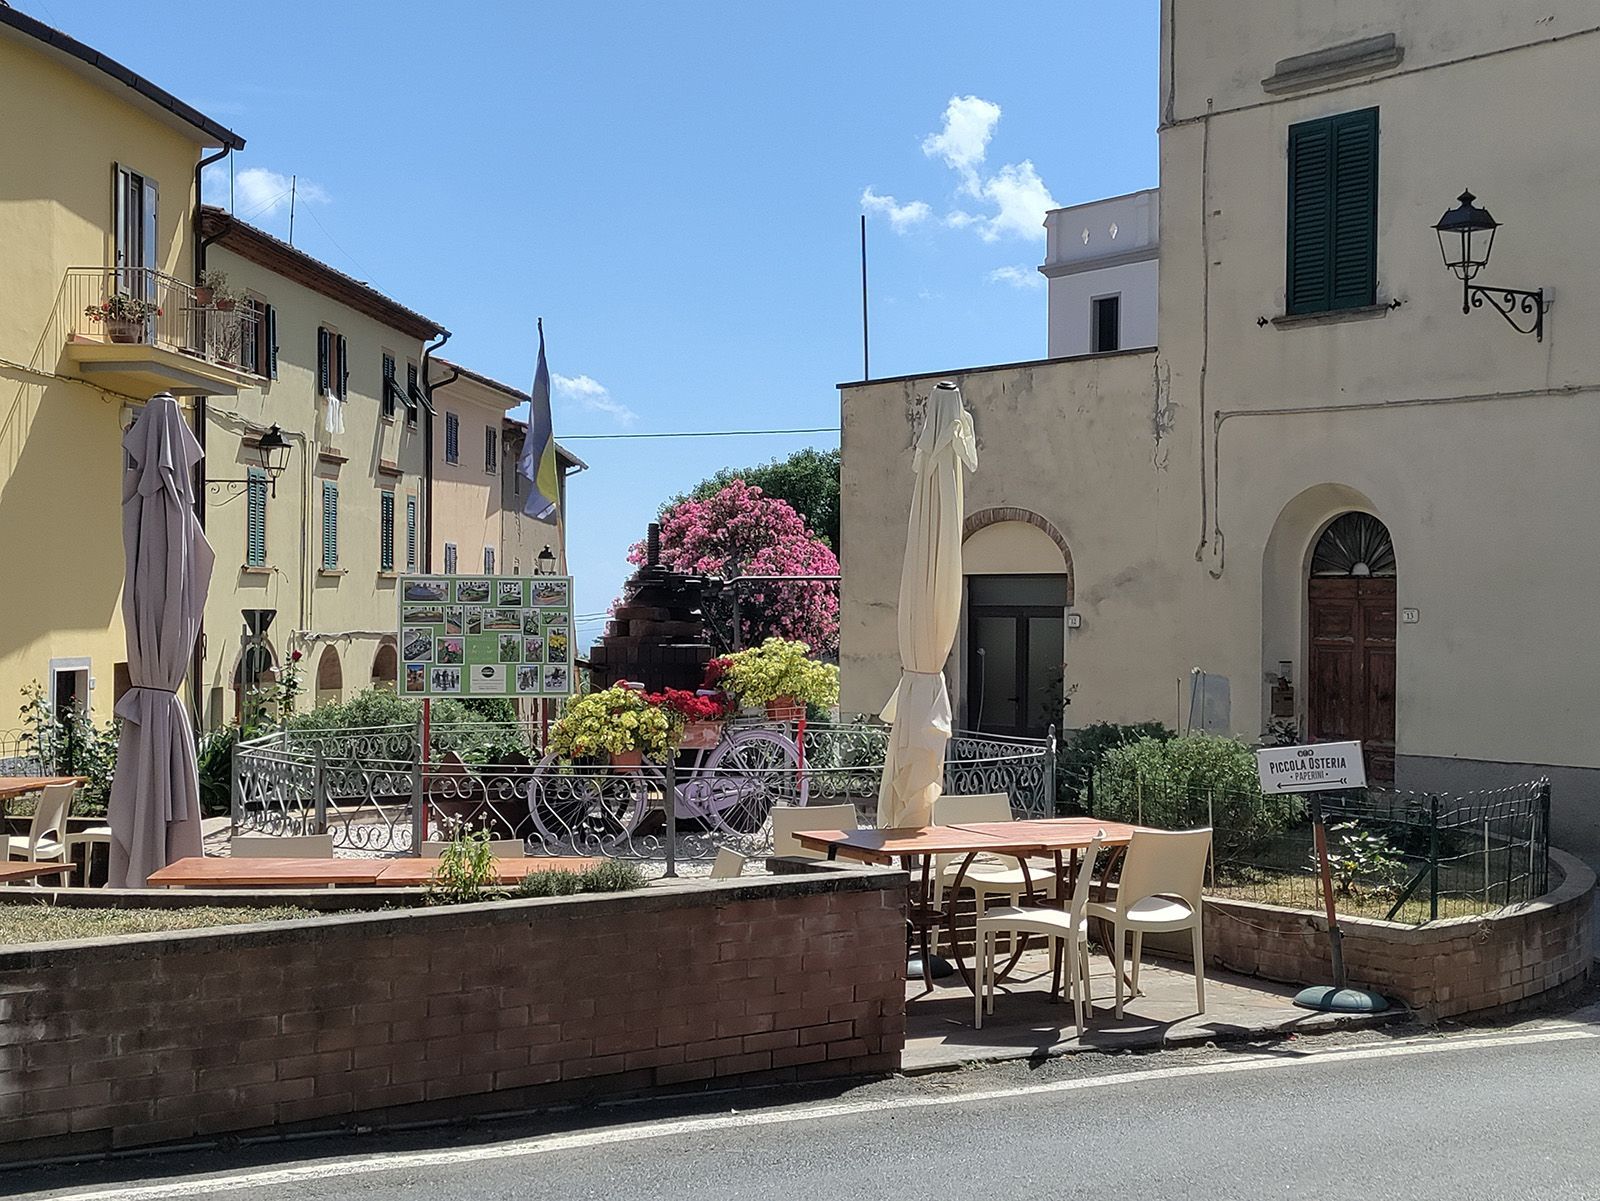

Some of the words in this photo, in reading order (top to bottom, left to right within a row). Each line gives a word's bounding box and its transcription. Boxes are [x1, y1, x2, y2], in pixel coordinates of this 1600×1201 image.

[1269, 759, 1307, 774] PICCOLA
[1309, 757, 1347, 769] OSTERIA
[1295, 771, 1324, 781] PAPERINI
